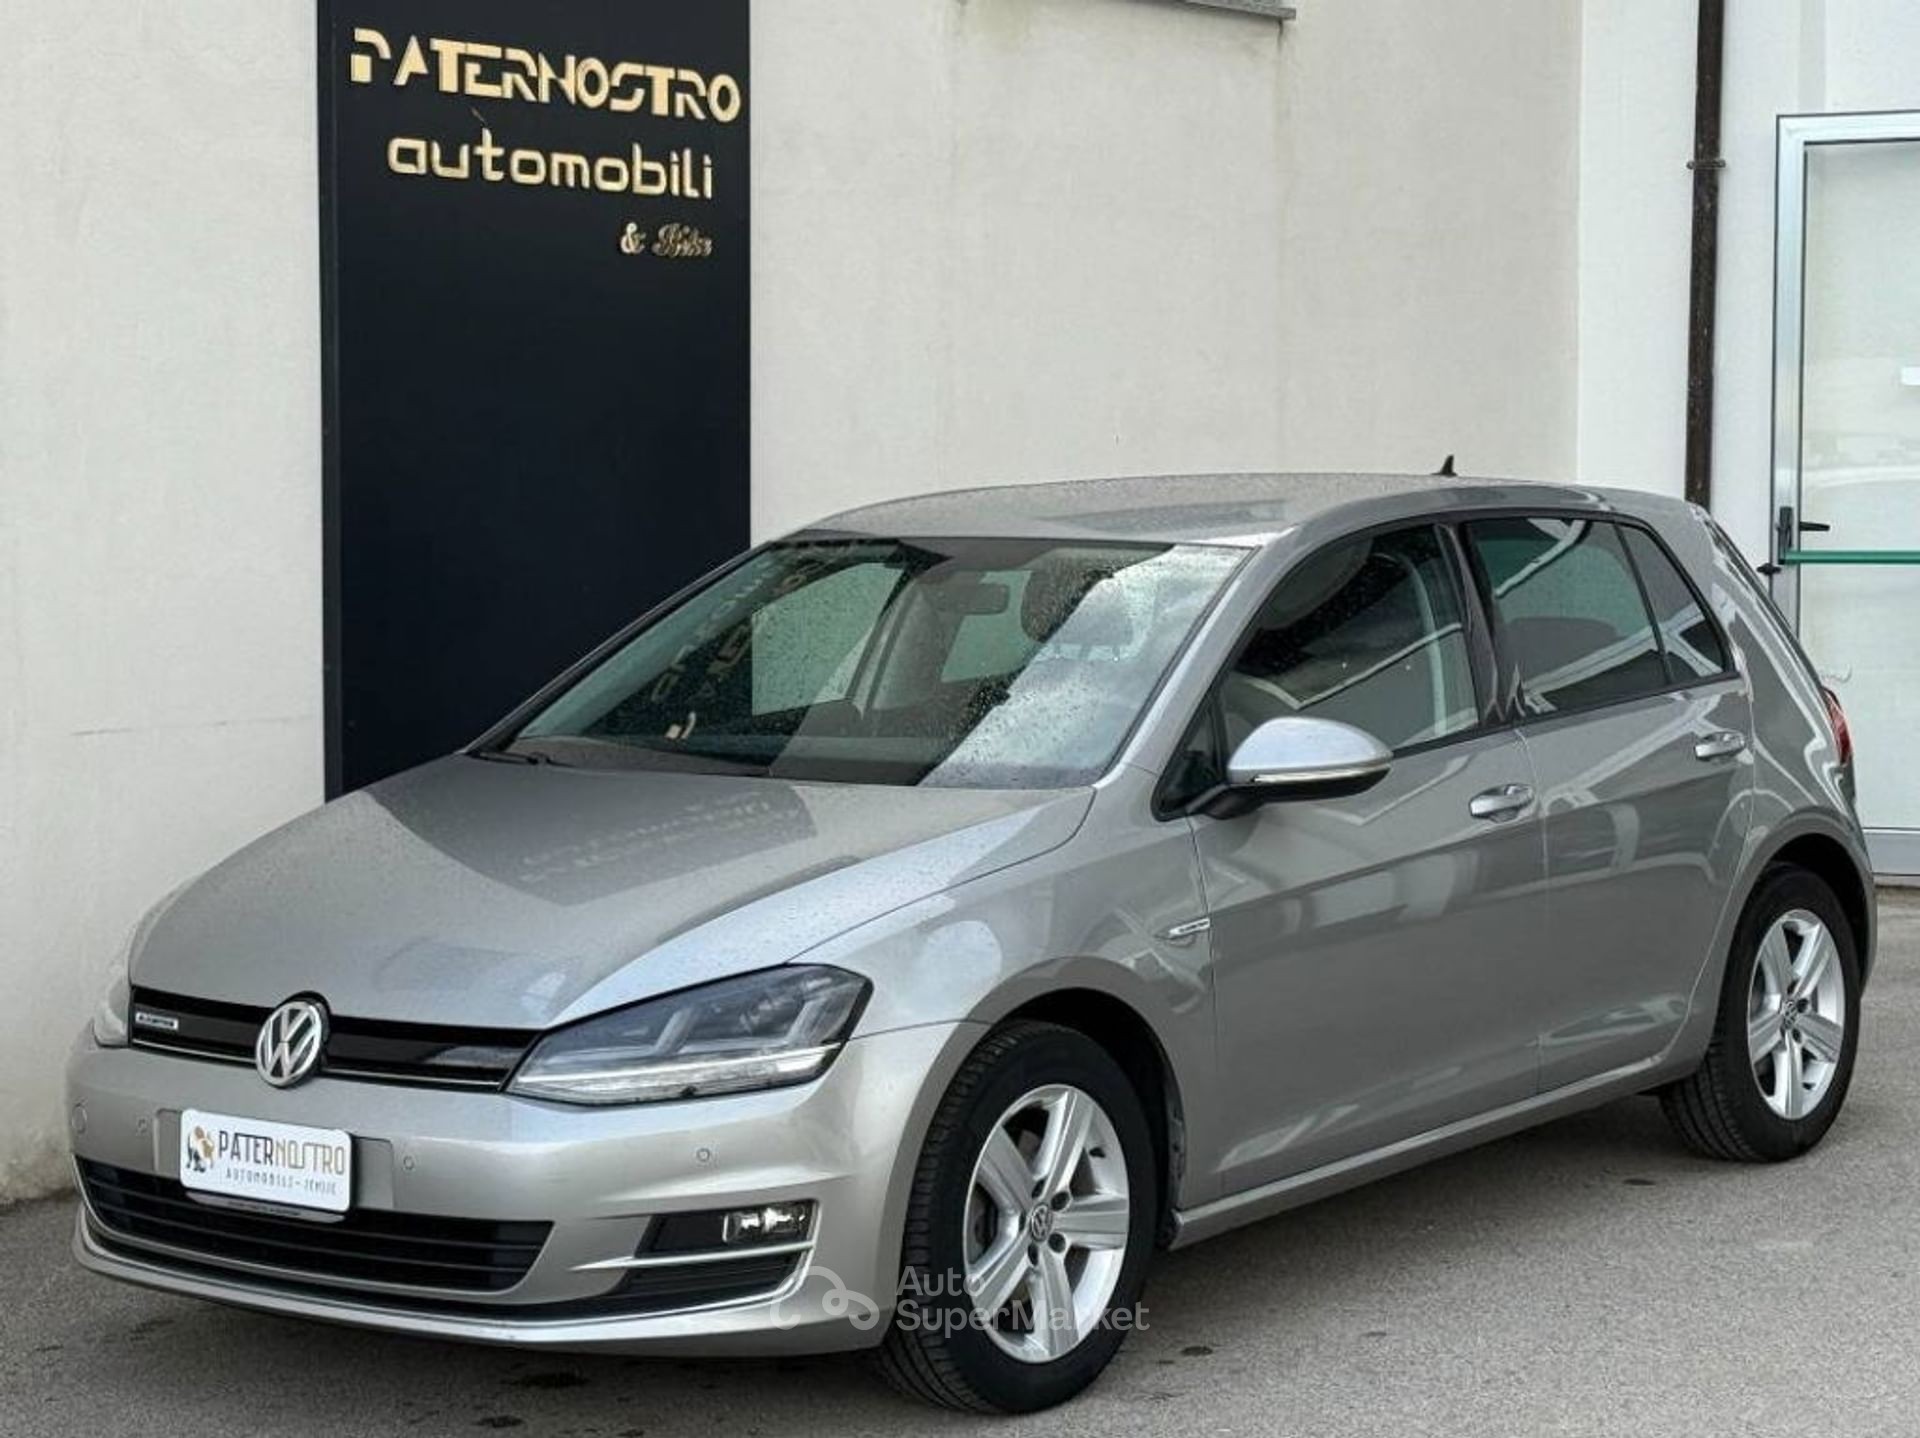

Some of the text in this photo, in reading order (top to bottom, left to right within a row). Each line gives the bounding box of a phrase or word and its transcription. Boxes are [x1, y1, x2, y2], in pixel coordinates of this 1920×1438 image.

[350, 28, 741, 123] PATERNOSTRO
[387, 128, 713, 200] automobili
[621, 222, 646, 254] &
[219, 1130, 345, 1175] PATERNOSTRO
